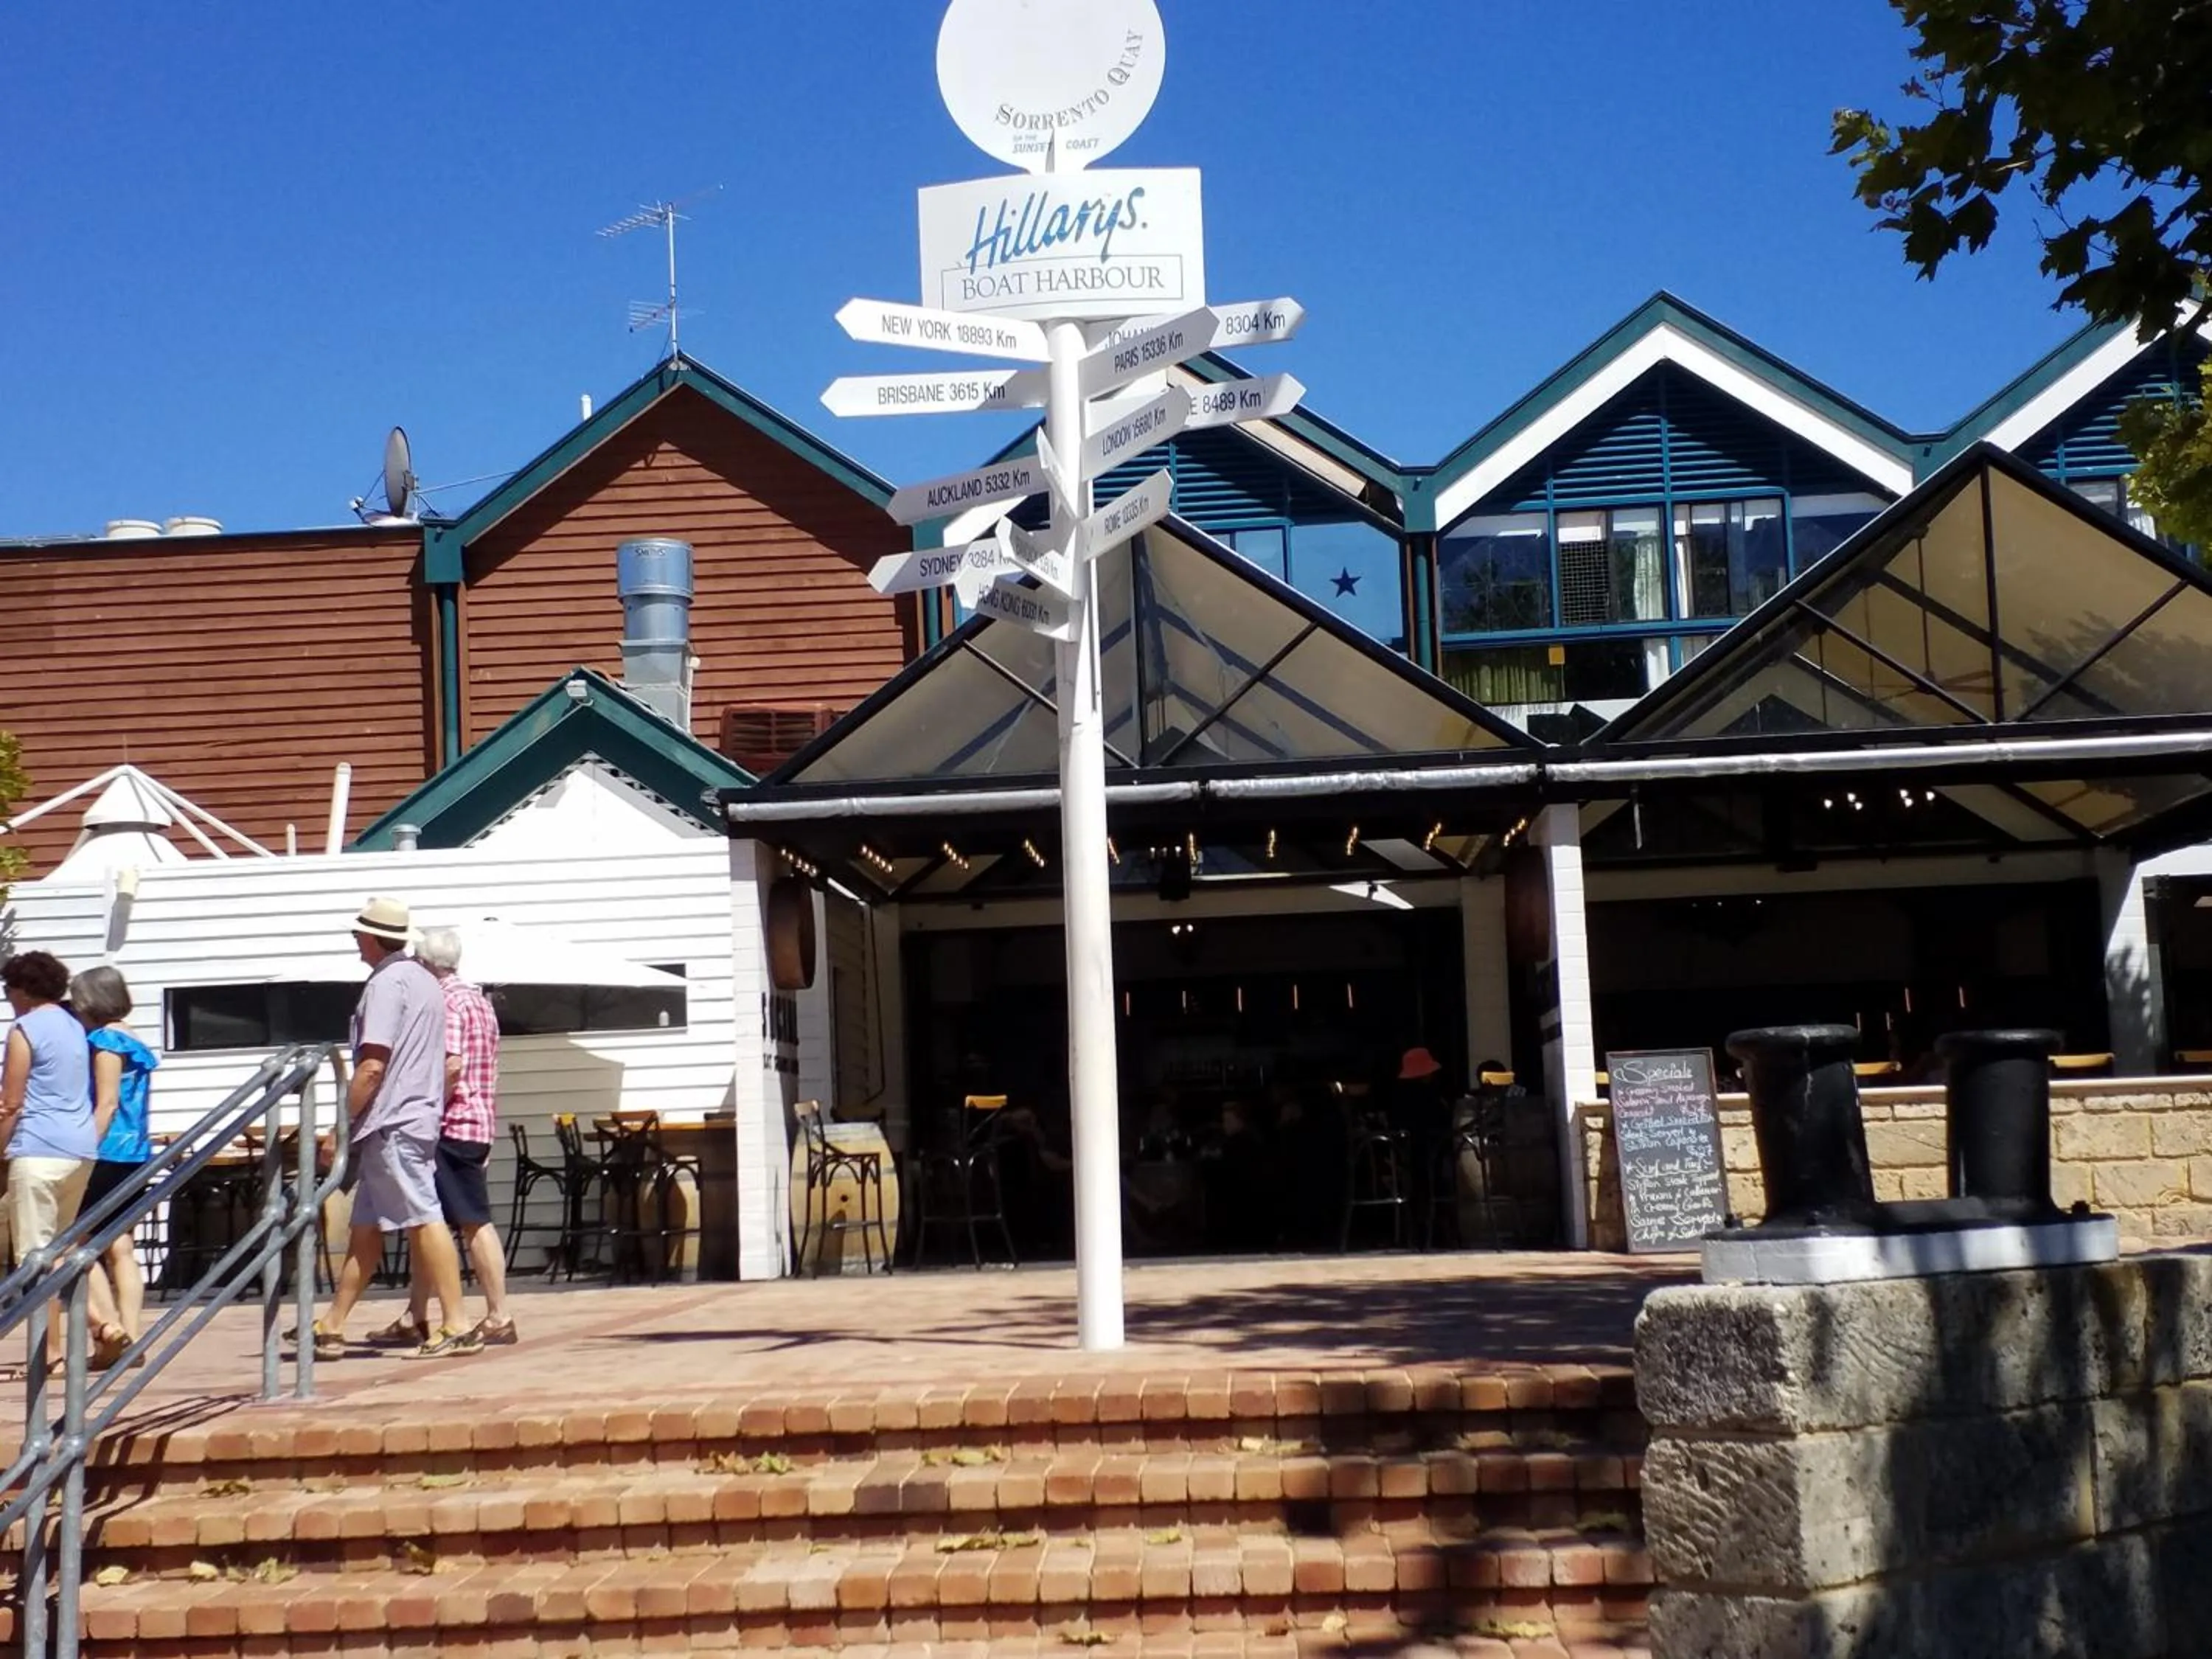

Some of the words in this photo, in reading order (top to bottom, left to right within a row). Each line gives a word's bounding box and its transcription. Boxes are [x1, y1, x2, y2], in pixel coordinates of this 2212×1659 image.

[1107, 28, 1143, 86] QUAY
[1065, 138, 1100, 150] COAST
[962, 272, 1029, 299] BOAT
[1036, 265, 1165, 291] HARBOUR
[882, 315, 912, 335] NEW
[917, 320, 951, 341] YORK
[957, 325, 993, 346] 18893
[996, 330, 1017, 349] Km
[1225, 315, 1259, 334] 8304
[1264, 310, 1285, 329] Km
[1114, 347, 1139, 373] PARIS
[1169, 330, 1183, 351] Km
[877, 384, 945, 405] BRISBANE
[949, 382, 978, 400] 3615
[983, 381, 1005, 401] Km
[1202, 394, 1236, 414] 8489
[1239, 389, 1262, 408] Km
[1102, 424, 1130, 456] LONDON
[1154, 407, 1166, 427] Km
[927, 478, 981, 507] AUCKLAND
[985, 473, 1010, 493] 5332
[1012, 467, 1030, 487] Km
[919, 554, 964, 577] SYDNEY
[1613, 1060, 1693, 1086] Specials
